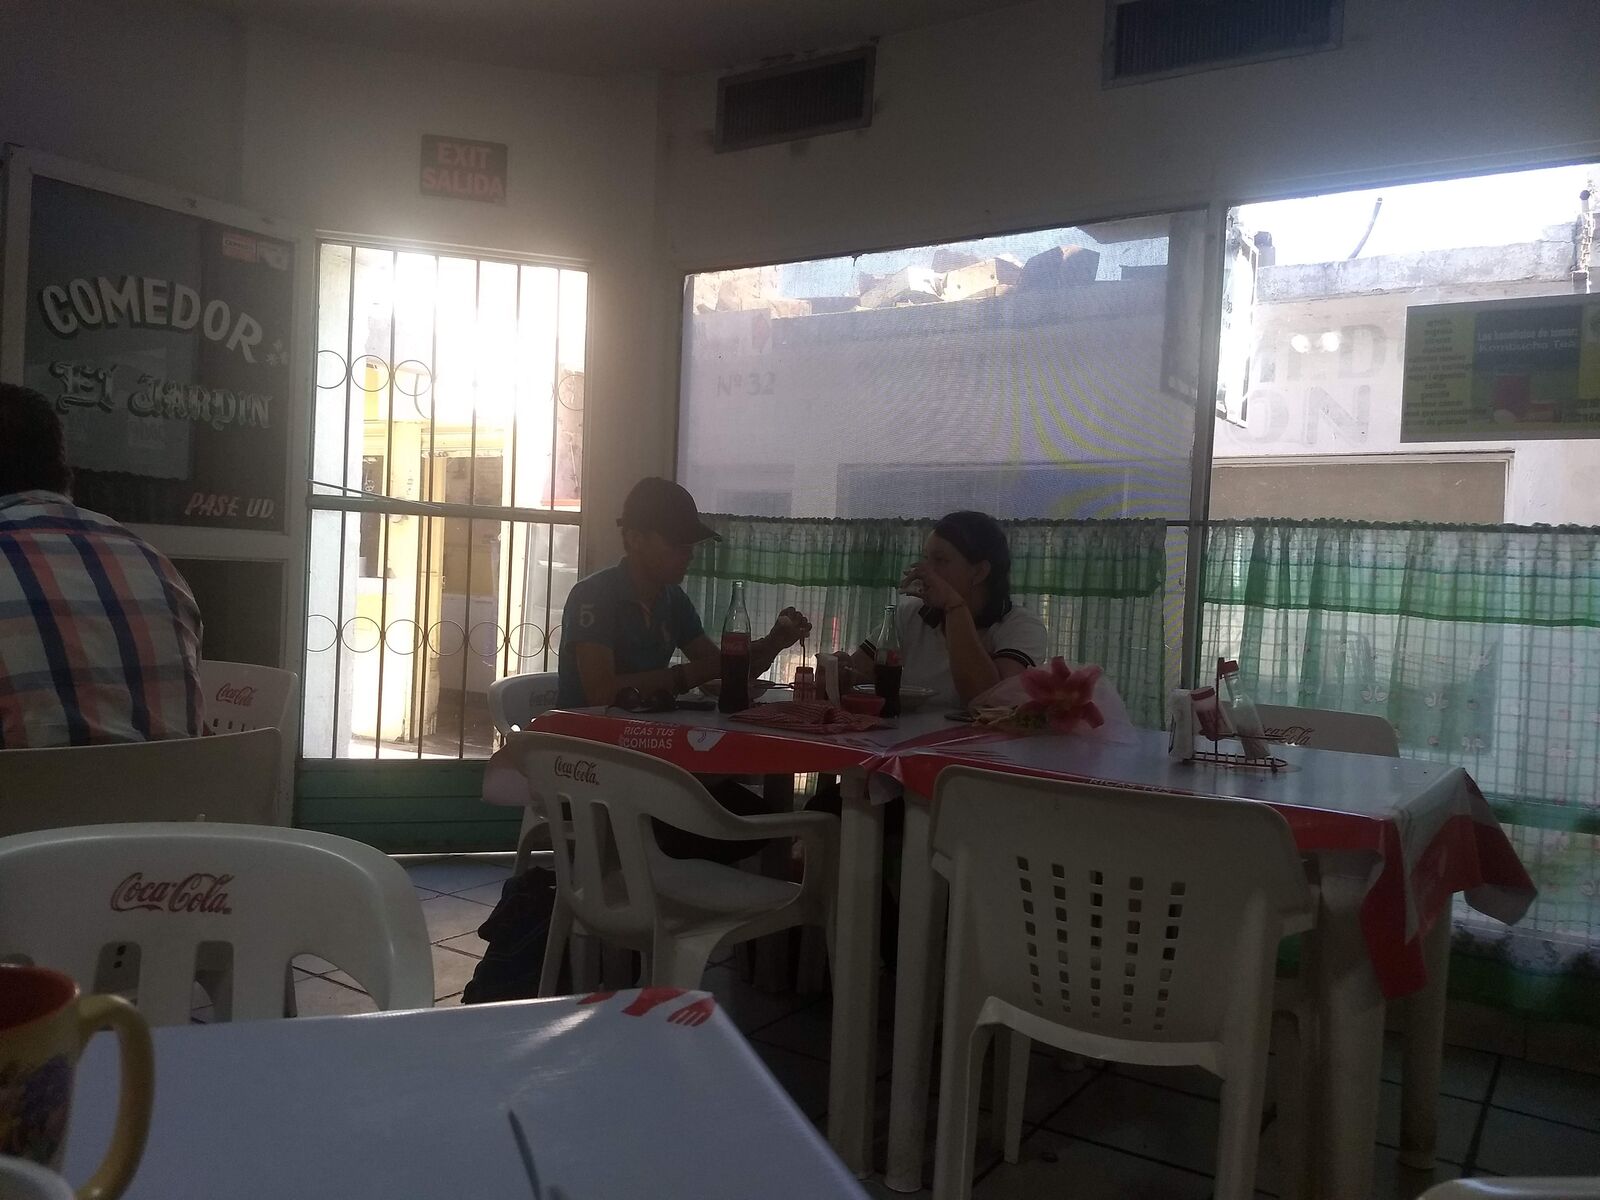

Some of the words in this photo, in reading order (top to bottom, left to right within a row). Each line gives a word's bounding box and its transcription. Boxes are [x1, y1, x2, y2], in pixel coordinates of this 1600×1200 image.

[438, 142, 490, 168] EXIT
[422, 168, 504, 198] SALIDA
[40, 275, 263, 363] COMEDOR
[747, 371, 775, 396] 32
[185, 492, 238, 518] PASE
[579, 603, 595, 628] 5
[623, 726, 653, 736] RICAS
[656, 727, 676, 737] TUS
[623, 738, 673, 750] COMIDAS
